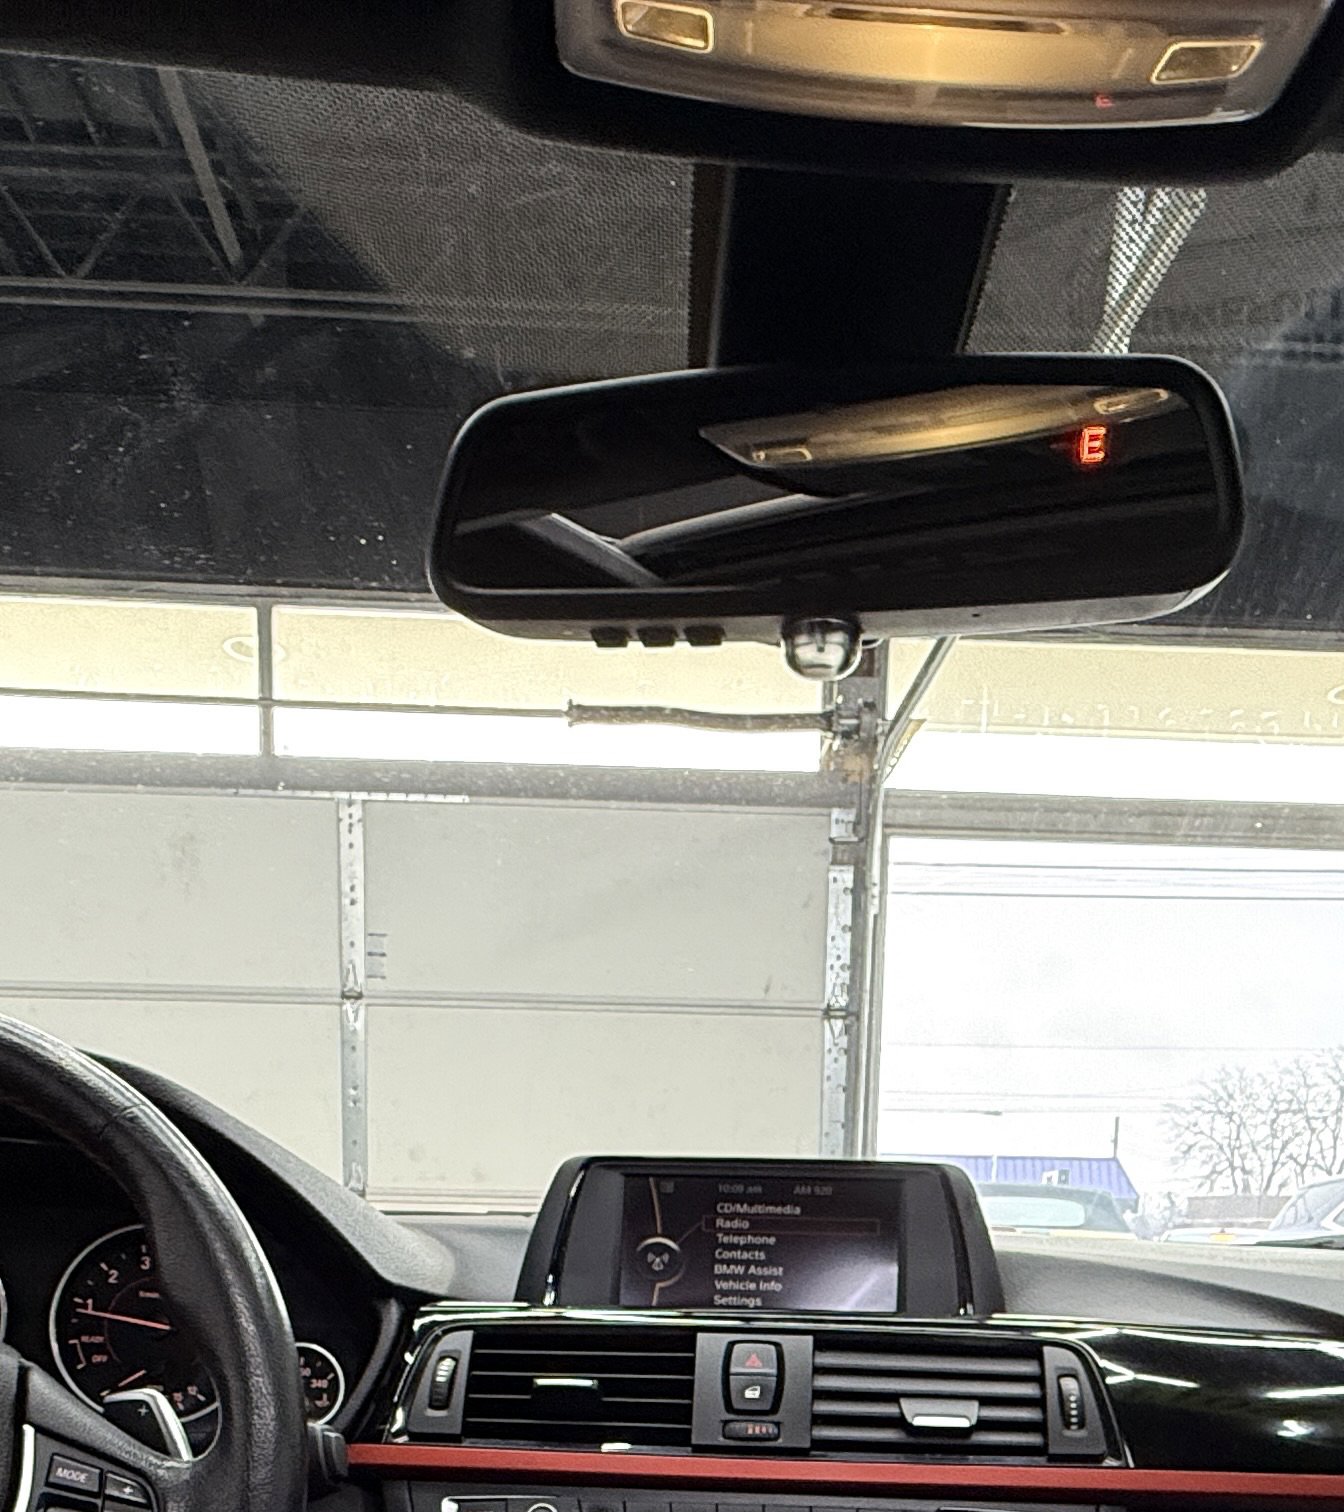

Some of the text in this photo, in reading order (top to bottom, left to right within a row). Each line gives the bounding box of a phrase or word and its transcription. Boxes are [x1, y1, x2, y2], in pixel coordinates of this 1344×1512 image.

[1079, 425, 1107, 464] E
[716, 1202, 802, 1216] CD/Multimedia
[715, 1218, 750, 1229] Radio
[716, 1233, 777, 1247] Telephone
[714, 1249, 766, 1261] Contacts
[140, 1255, 152, 1271] 3
[107, 1269, 120, 1284] 2
[713, 1264, 784, 1277] BMW Assist
[714, 1279, 783, 1292] Vehicle Info
[713, 1294, 763, 1308] Settings
[56, 1466, 89, 1483] MODE
